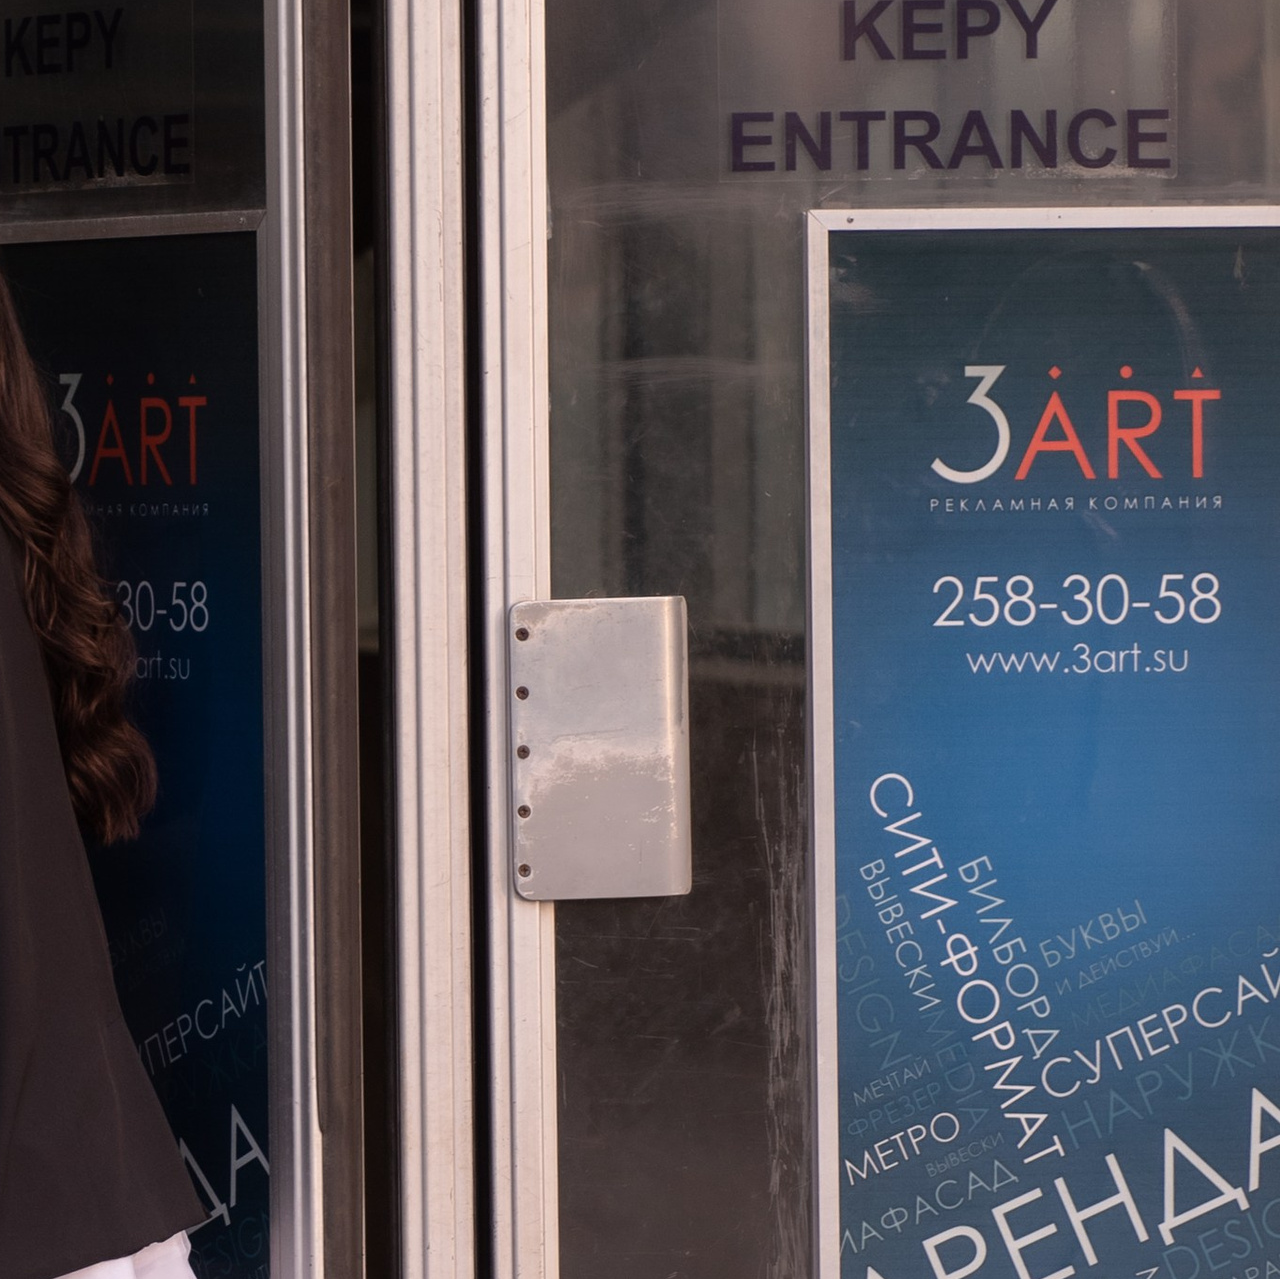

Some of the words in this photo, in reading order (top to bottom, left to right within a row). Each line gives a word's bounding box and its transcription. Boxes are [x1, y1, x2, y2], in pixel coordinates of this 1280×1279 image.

[4, 8, 124, 77] КЕРУ
[730, 108, 1172, 173] ENTRANCE
[930, 364, 1221, 484] 3ART
[129, 502, 210, 517] КОМПАНИЯ
[930, 497, 1074, 512] РЕКЛАМНАЯ
[1089, 495, 1223, 511] КОМПАНИЯ
[117, 580, 210, 632] 30-58
[932, 572, 1222, 627] 258-30-58
[966, 642, 1190, 674] www.3art.su
[859, 858, 942, 1012] ВЫВЕСКИ
[958, 855, 1060, 1060] БИЛБОРД
[1038, 899, 1148, 968] БУКВЫ
[870, 773, 1066, 1164] СИТИ-ФОРМАТ
[1054, 978, 1072, 996] И
[137, 960, 268, 1076] ПЕРСАЙТ
[847, 1082, 941, 1138] ФРЕЗЕР
[853, 1056, 931, 1106] МЕЧТАЙ
[843, 1111, 961, 1186] МЕТРО
[925, 1131, 1005, 1178] ВЫВЕСКИ
